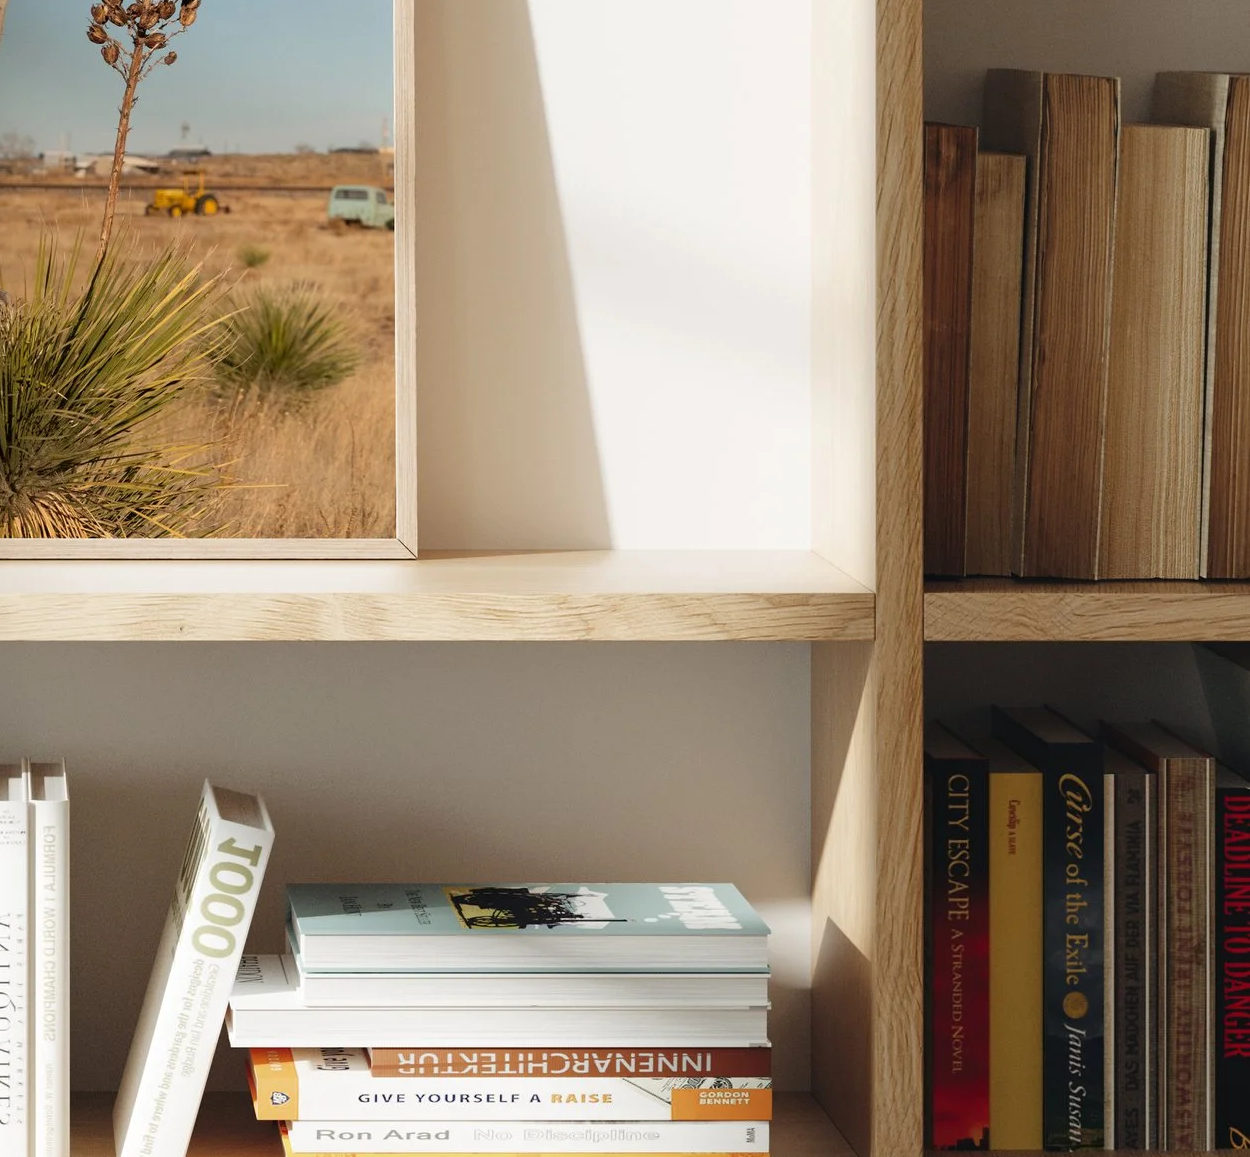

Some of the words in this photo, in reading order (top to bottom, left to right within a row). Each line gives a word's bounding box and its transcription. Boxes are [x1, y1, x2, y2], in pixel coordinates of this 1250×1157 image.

[948, 774, 969, 830] CITY
[1058, 773, 1092, 859] Curse
[948, 838, 969, 920] ESCAPE
[1066, 863, 1088, 886] of
[1224, 796, 1250, 915] DEADLINE
[1066, 892, 1088, 924] the
[952, 930, 963, 940] A
[1066, 933, 1088, 986] Exile
[1224, 926, 1250, 953] TO
[952, 944, 963, 1022] STRANDED
[1224, 964, 1250, 1058] DANGER
[398, 1052, 712, 1074] INNENARCHITEKTUR
[952, 1025, 963, 1074] NOVEL
[1062, 1023, 1087, 1075] Janis
[358, 1091, 407, 1105] GIVE
[416, 1091, 523, 1105] YOURSELF
[530, 1091, 542, 1105] A
[550, 1091, 613, 1105] RAISE
[1068, 1082, 1087, 1142] Susan
[316, 1129, 372, 1141] Ron
[383, 1129, 450, 1141] Arad
[474, 1129, 515, 1141] No
[523, 1128, 660, 1143] Discipline
